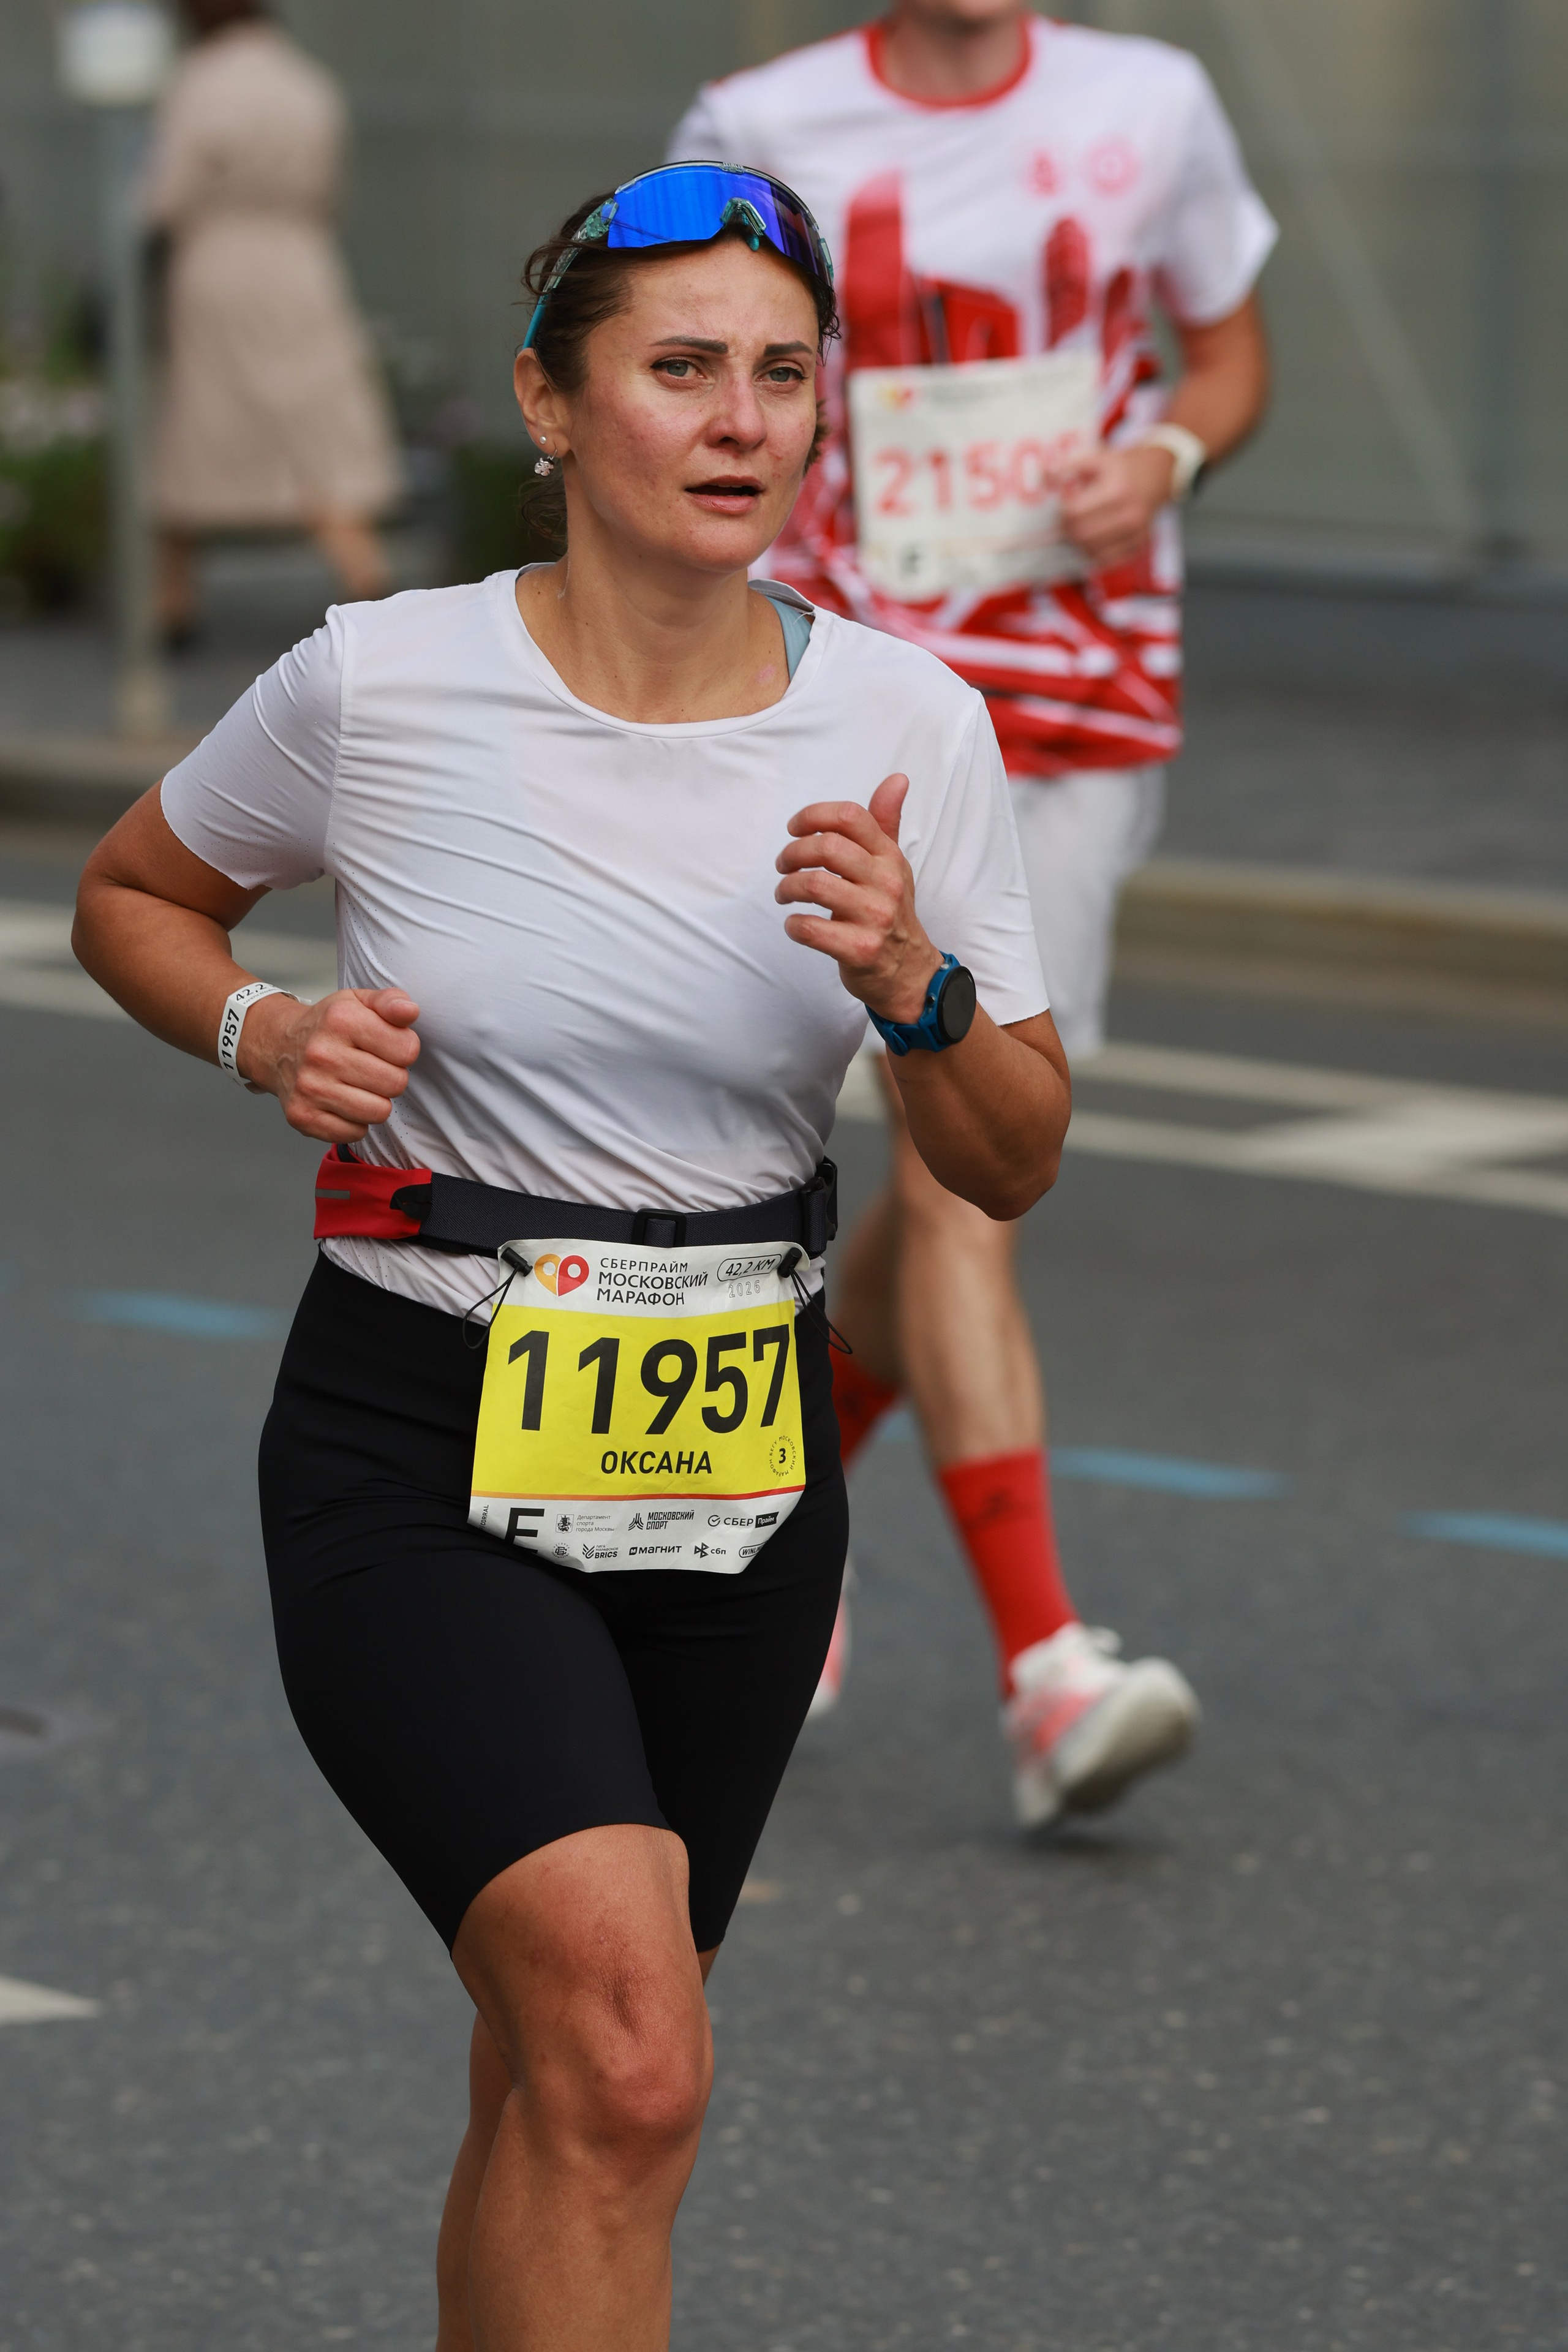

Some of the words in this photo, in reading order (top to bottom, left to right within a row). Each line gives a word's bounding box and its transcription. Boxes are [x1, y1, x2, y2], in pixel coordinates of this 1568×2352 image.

[236, 984, 266, 1001] 42.2
[221, 1008, 239, 1070] 11957
[600, 1257, 688, 1273] СБЕРПРАЙМ
[725, 1261, 753, 1276] 42,2
[598, 1271, 709, 1290] МОСКОВСКИЙ
[728, 1280, 761, 1298] 2026
[597, 1288, 685, 1306] МАРАФОН
[508, 1324, 790, 1434] 11957
[600, 1450, 712, 1474] ОКСАНА
[778, 1447, 786, 1464] 3
[647, 1509, 695, 1521] МОСКОВСКИЙ
[723, 1517, 754, 1526] СБЕР
[758, 1516, 775, 1525] Прайм
[503, 1507, 545, 1554] E
[646, 1521, 668, 1530] СПОРТ
